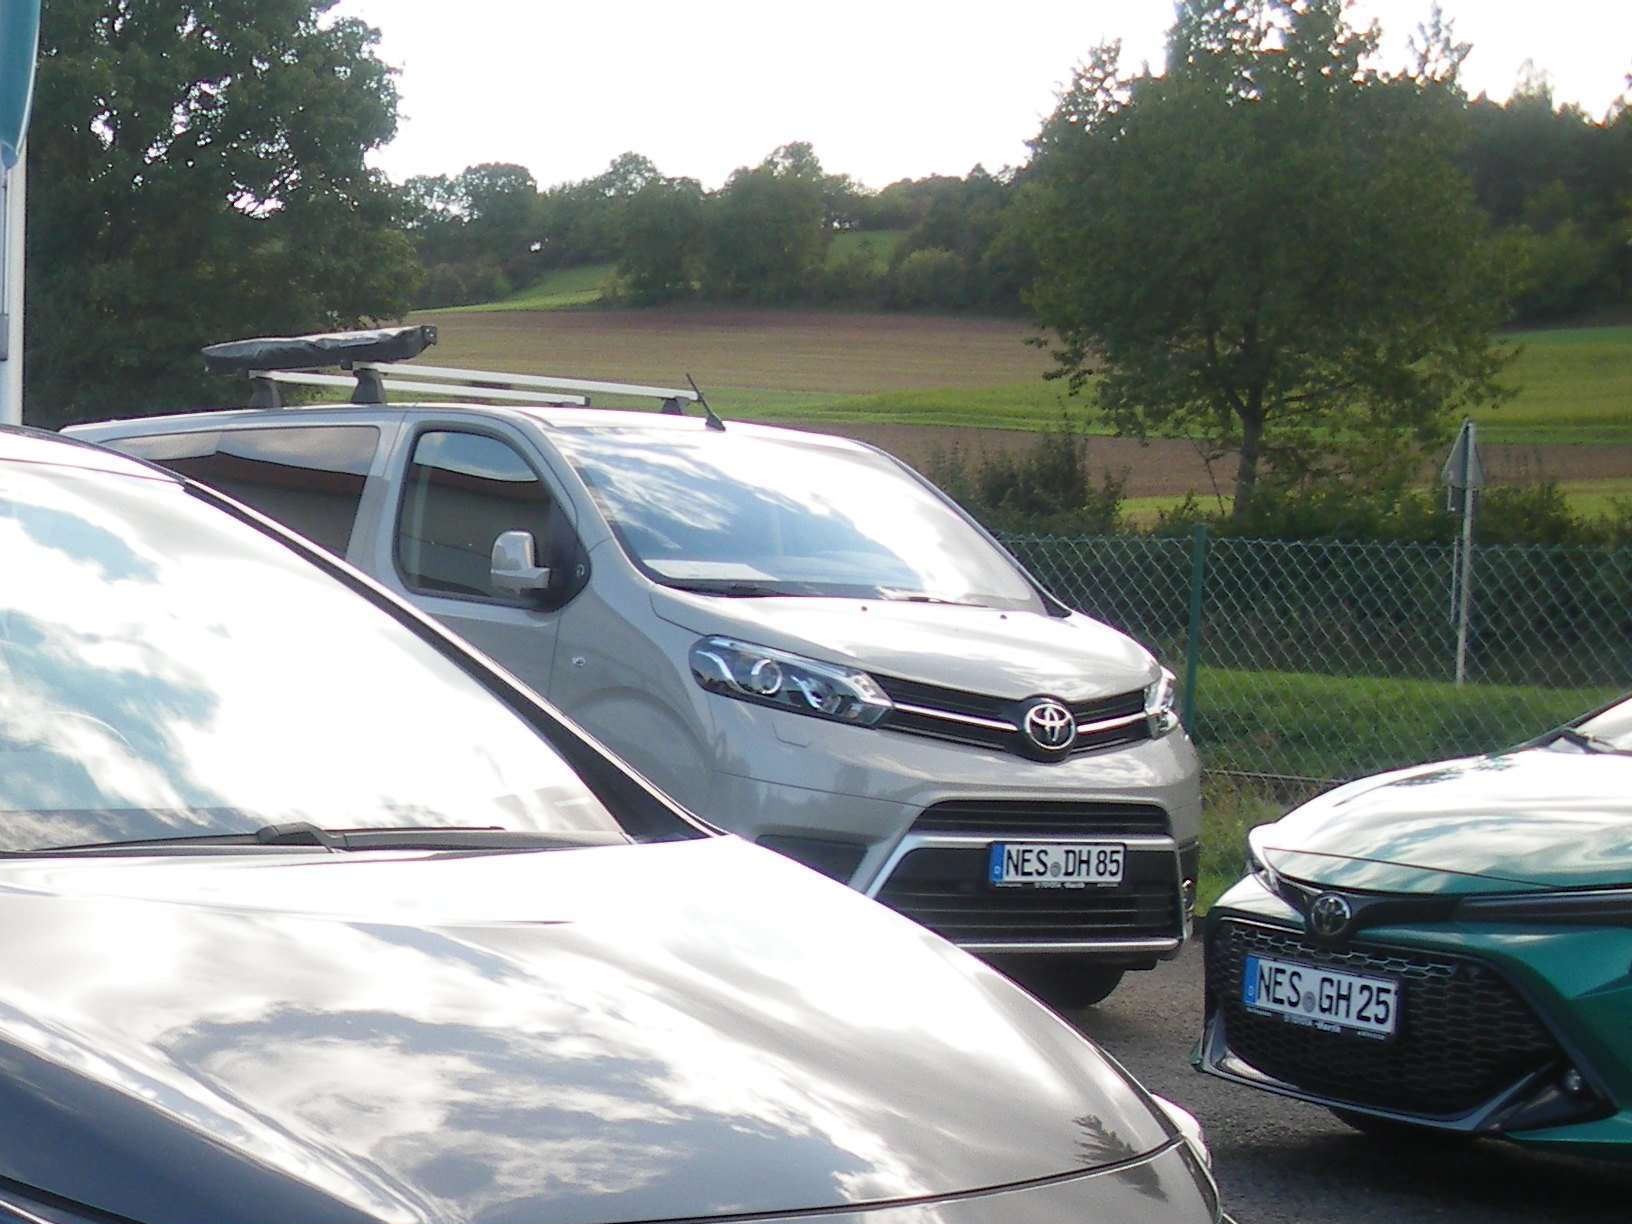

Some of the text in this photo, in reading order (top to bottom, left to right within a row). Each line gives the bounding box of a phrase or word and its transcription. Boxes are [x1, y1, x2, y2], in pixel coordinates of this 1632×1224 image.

[1006, 849, 1121, 877] NES DH 85
[1258, 965, 1301, 1007] NES
[1319, 977, 1352, 1018] GH
[1356, 984, 1391, 1025] 25
